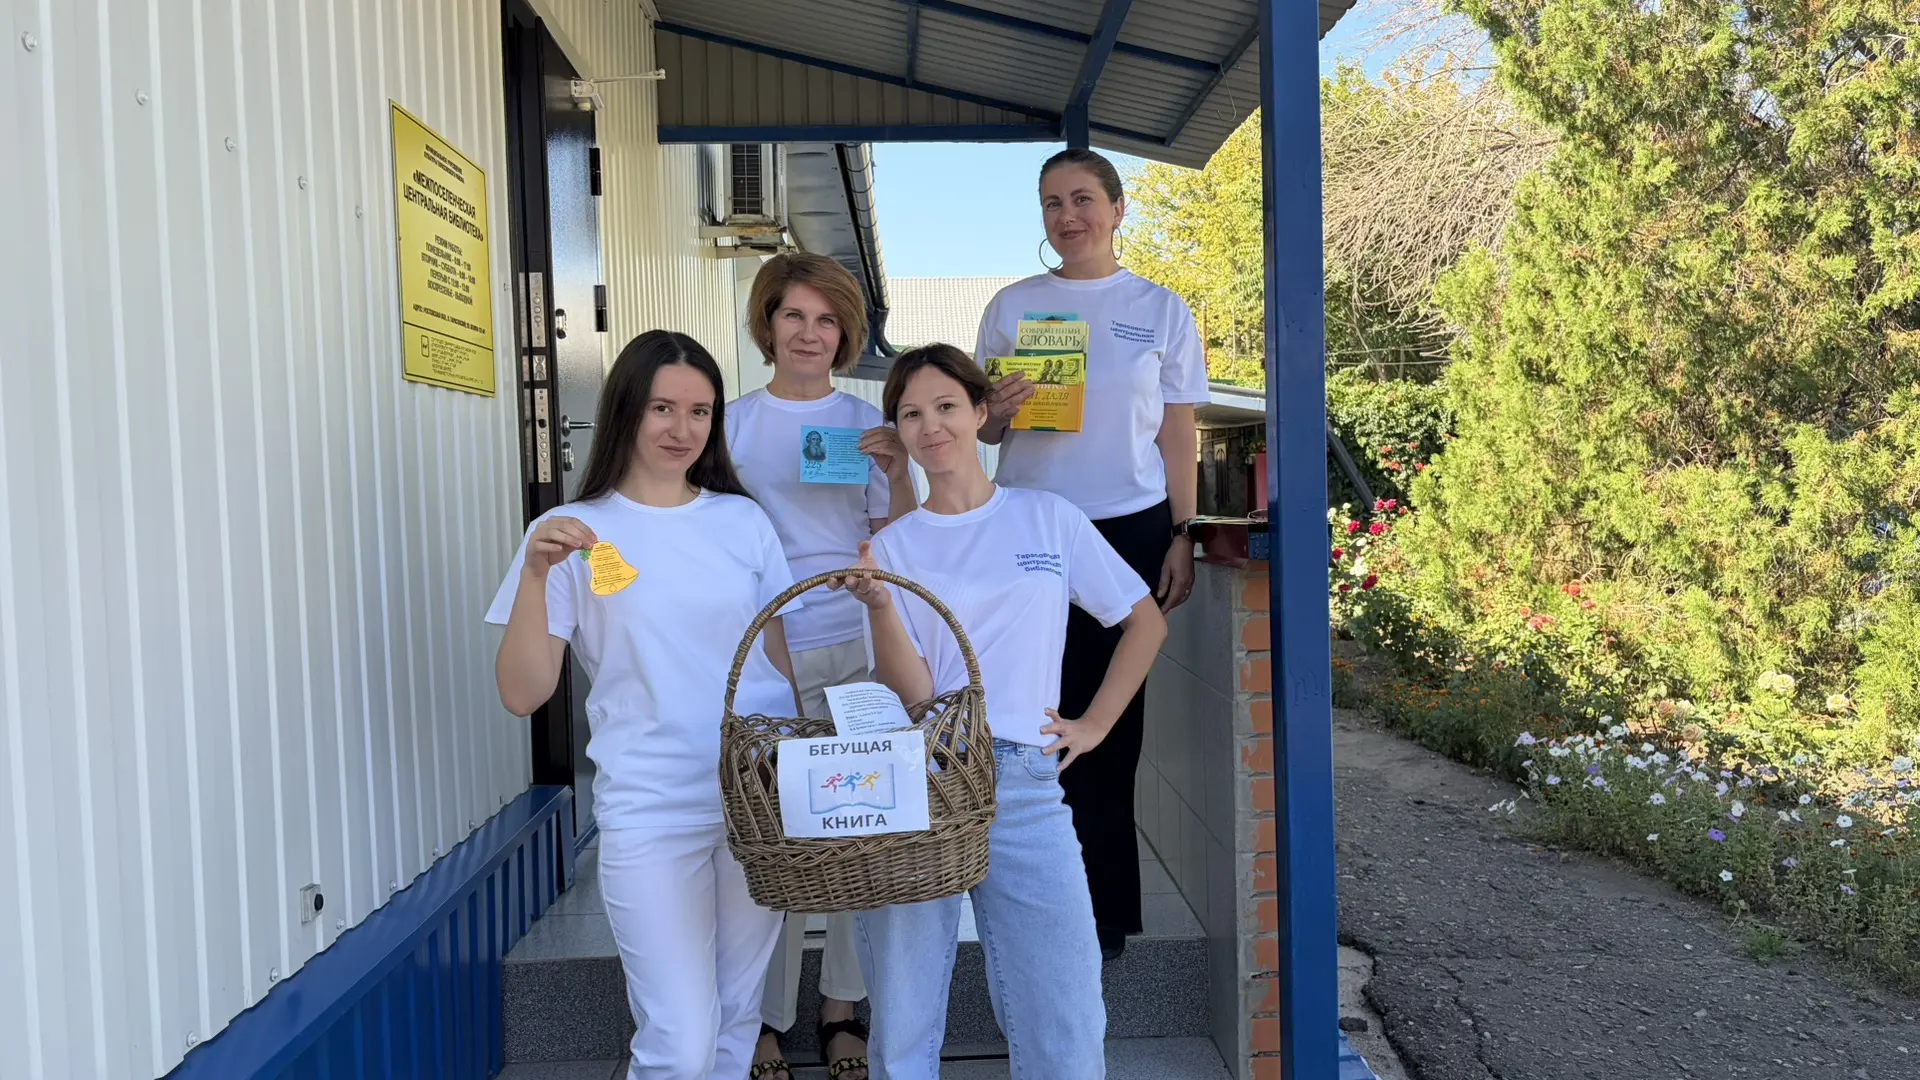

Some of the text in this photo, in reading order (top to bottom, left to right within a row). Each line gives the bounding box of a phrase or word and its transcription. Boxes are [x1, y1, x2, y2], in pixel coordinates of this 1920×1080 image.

[413, 169, 476, 219] «МЕЖПОСЕЛЕНЧЕСКАЯ
[403, 182, 484, 242] ЦЕНТРАЛЬНАЯ БИБЛИОТЕКА»
[1021, 326, 1080, 335] СОВРЕМЕННЫЙ
[1110, 327, 1154, 338] центральная
[1111, 320, 1155, 333] Тарасовская
[1020, 334, 1081, 347] СЛОВАРЬ
[1114, 333, 1155, 344] библиотека
[1042, 391, 1070, 401] ДАЛЯ
[804, 460, 822, 469] 225
[1015, 552, 1061, 560] Тарасовская
[809, 739, 892, 757] БЕГУЩАЯ
[822, 813, 888, 830] КНИГА
